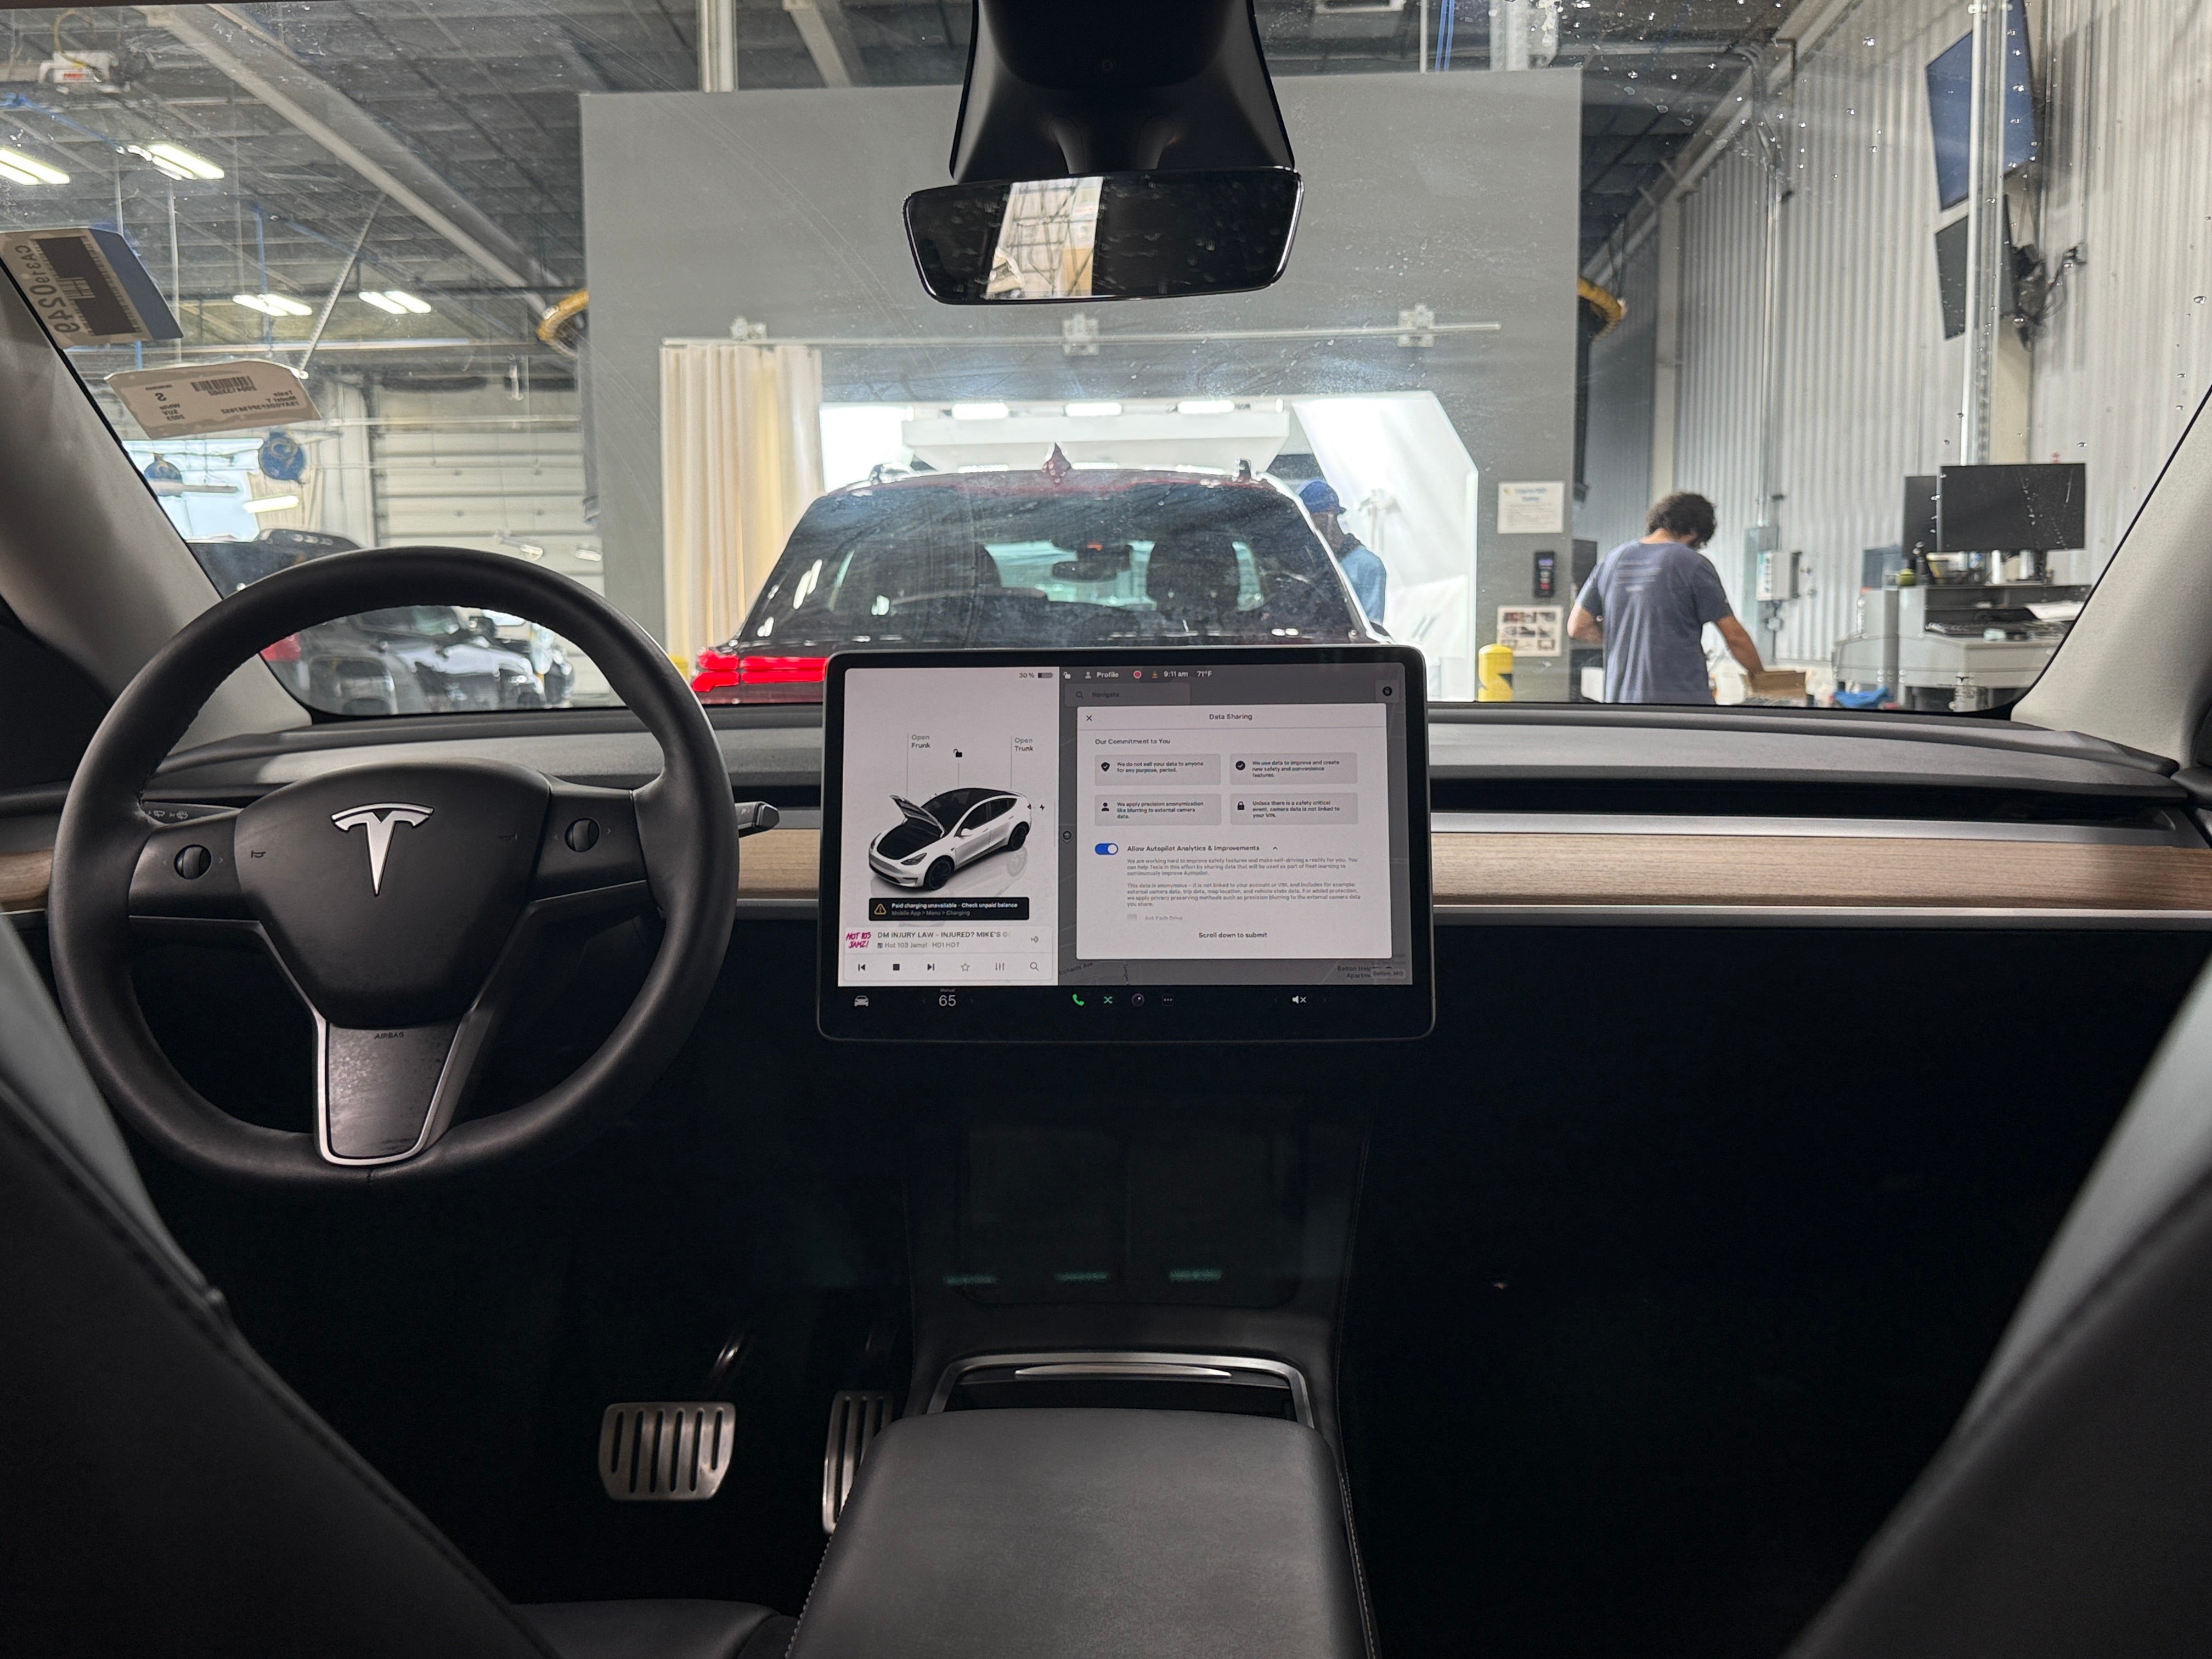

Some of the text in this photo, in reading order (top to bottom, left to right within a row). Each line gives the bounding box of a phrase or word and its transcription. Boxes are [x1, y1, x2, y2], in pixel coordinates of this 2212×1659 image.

[1226, 713, 1252, 721] Sharing
[847, 932, 860, 940] HOT
[939, 995, 956, 1007] 65
